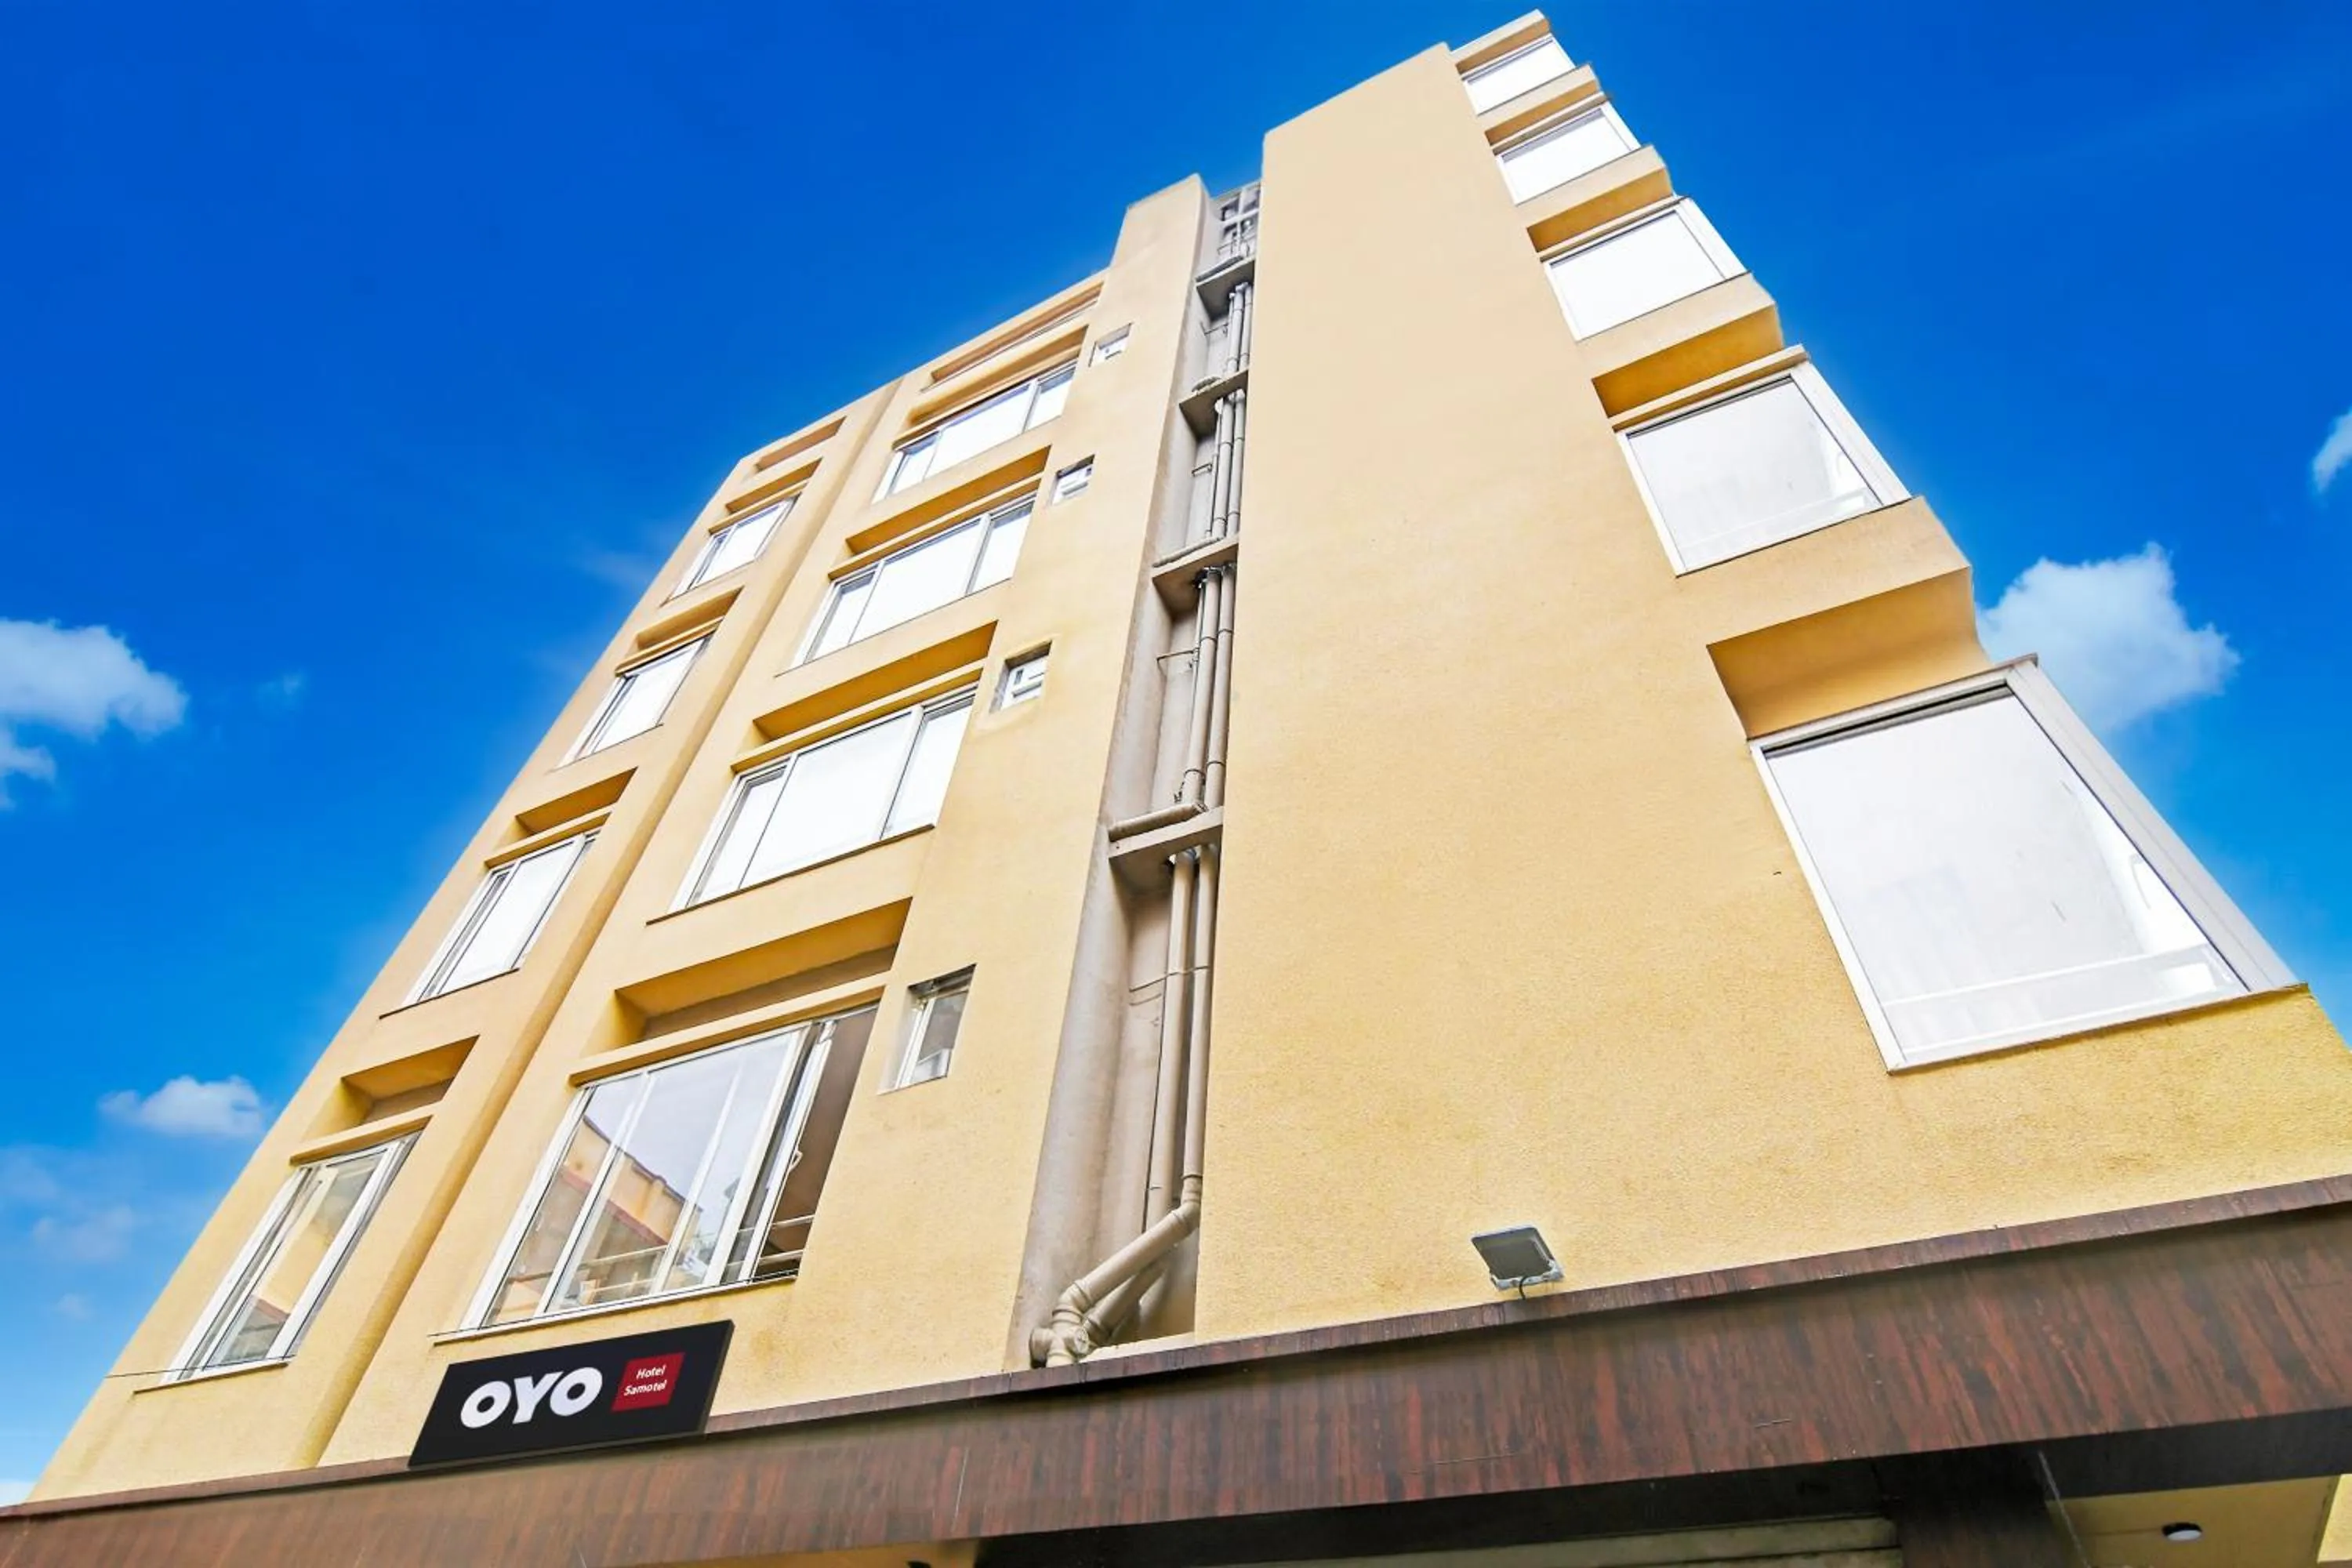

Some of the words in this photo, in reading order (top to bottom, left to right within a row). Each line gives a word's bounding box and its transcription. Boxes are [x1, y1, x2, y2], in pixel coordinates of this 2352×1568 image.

[636, 1364, 666, 1380] Hotel
[623, 1379, 667, 1396] Samotel
[460, 1367, 604, 1428] OYO
